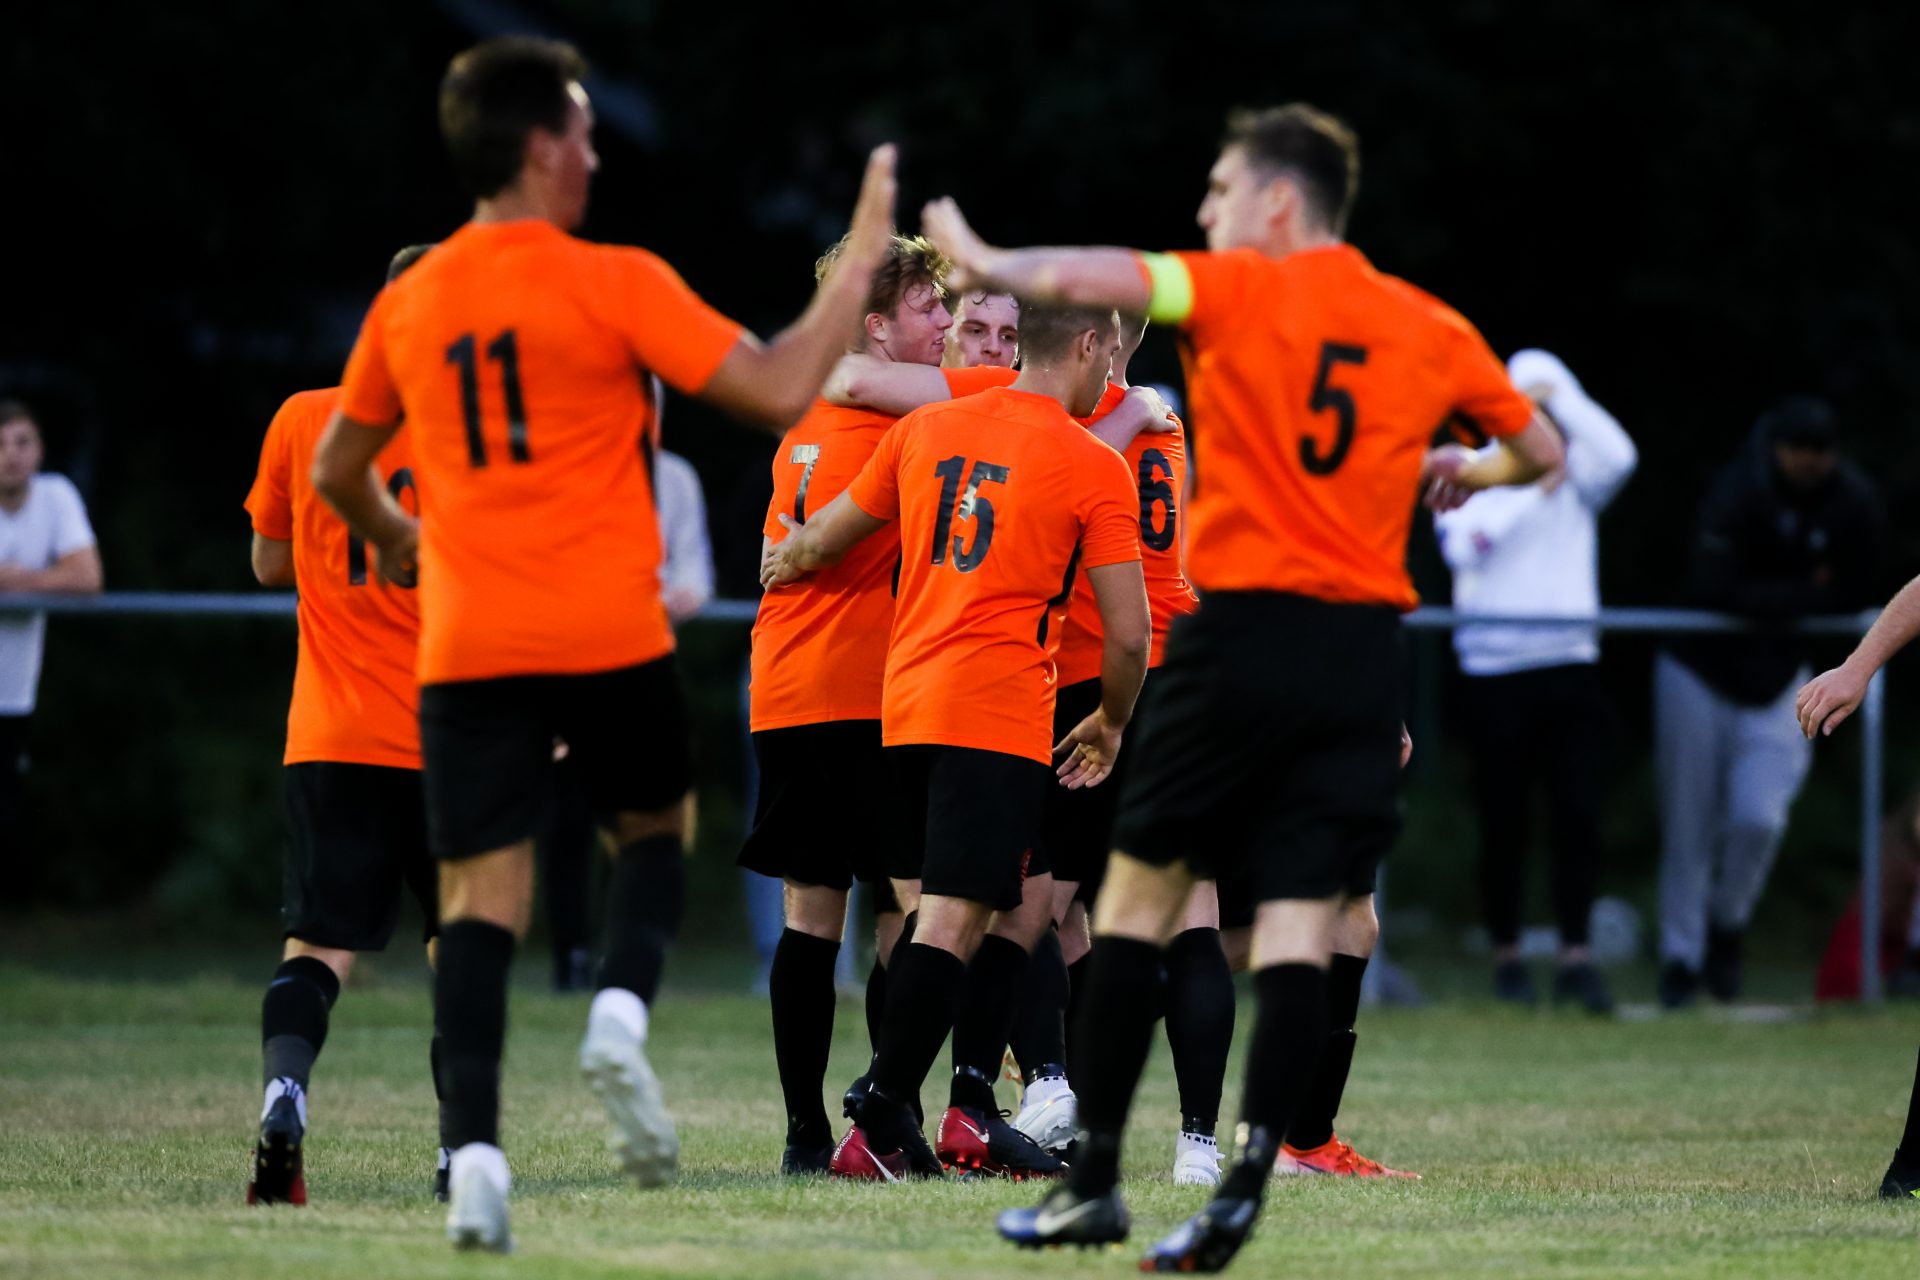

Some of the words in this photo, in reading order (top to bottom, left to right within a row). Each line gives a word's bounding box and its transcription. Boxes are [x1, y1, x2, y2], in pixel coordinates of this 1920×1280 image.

[446, 329, 532, 468] 11
[1299, 339, 1368, 477] 5
[790, 443, 821, 526] 7
[931, 455, 1010, 574] 15
[1138, 448, 1176, 552] 6
